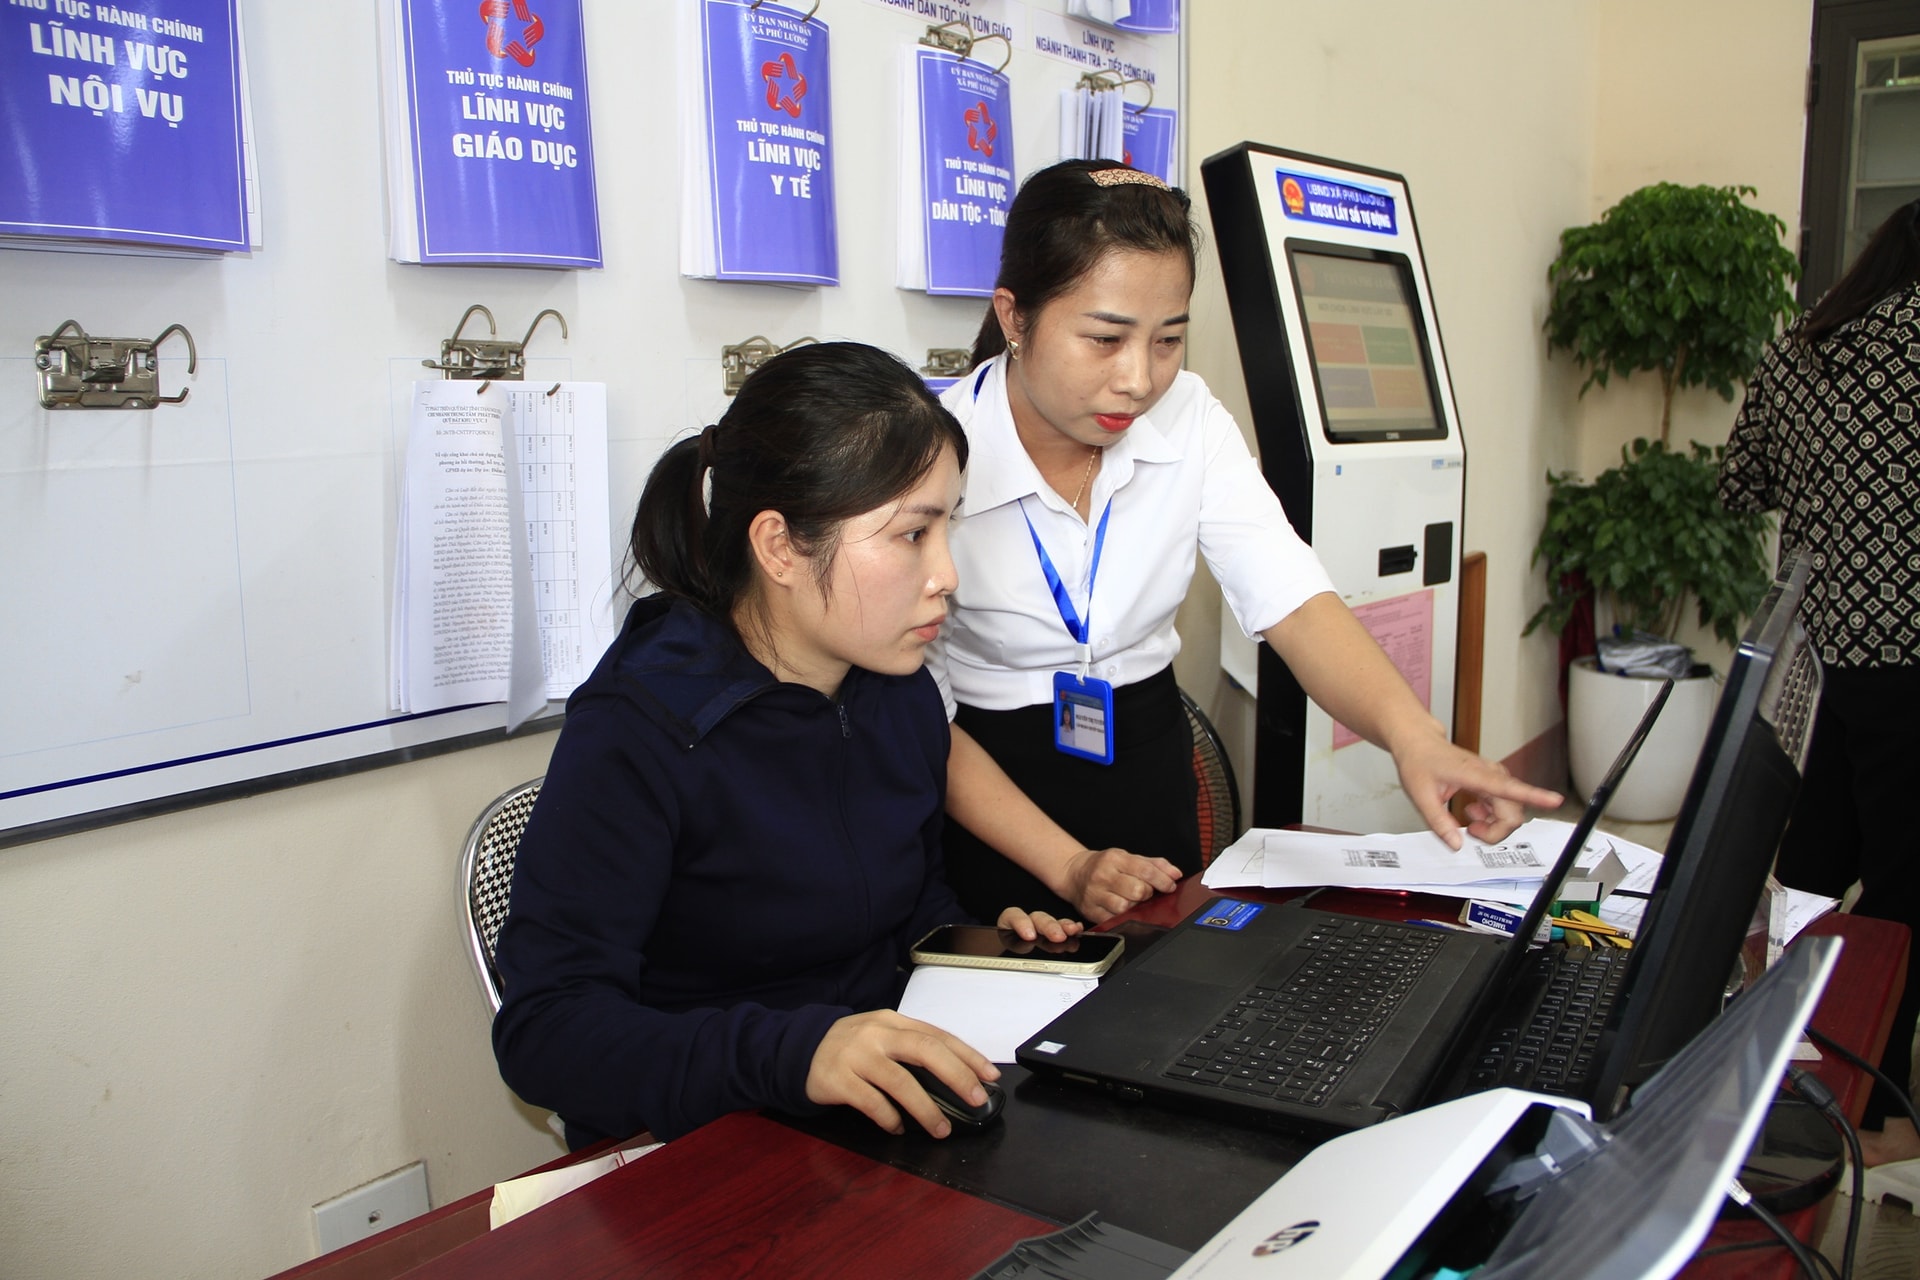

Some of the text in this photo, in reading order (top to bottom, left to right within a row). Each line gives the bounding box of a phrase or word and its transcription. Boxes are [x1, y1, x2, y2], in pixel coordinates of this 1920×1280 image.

[55, 0, 90, 19] TỤC
[96, 5, 147, 30] HÀNH
[152, 18, 204, 42] CHÍNH
[752, 24, 808, 46] XÃ PHÚ LƯƠNG
[759, 16, 776, 26] BAN
[777, 20, 798, 32] NHÂN
[799, 25, 812, 37] DÂN
[972, 15, 989, 34] TÔN
[992, 22, 1012, 41] GIÁO
[30, 20, 188, 80] LĨNH VỰC
[1082, 30, 1115, 54] LĨNH VỰC
[1036, 36, 1062, 56] NGÀNH
[1063, 44, 1087, 62] THANH
[1088, 52, 1101, 68] TRA
[1124, 62, 1141, 80] CÔNG
[446, 68, 573, 100] THỦ TỤC HÀNH CHÍNH
[957, 78, 966, 86] XÃ
[962, 70, 974, 78] BAN
[49, 74, 184, 128] NỘI VỤ
[462, 92, 565, 133] LĨNH VỰC
[736, 118, 825, 146] THỦ TỤC HÀNH CHÍNH
[452, 130, 577, 170] GIÁO DỤC
[748, 138, 821, 173] LĨNH VỰC
[944, 156, 961, 169] THỦ
[963, 160, 977, 173] TỤC
[978, 162, 996, 176] HÀNH
[770, 174, 811, 199] Y TẾ
[956, 174, 1006, 204] LĨNH VỰC
[932, 199, 959, 220] DÂN
[961, 201, 981, 226] TỘC
[989, 205, 1006, 227] TÔN
[1309, 201, 1334, 220] KIOSK
[1334, 202, 1349, 222] LẤY
[1349, 205, 1361, 223] SỐ
[1361, 210, 1371, 228] TỰ
